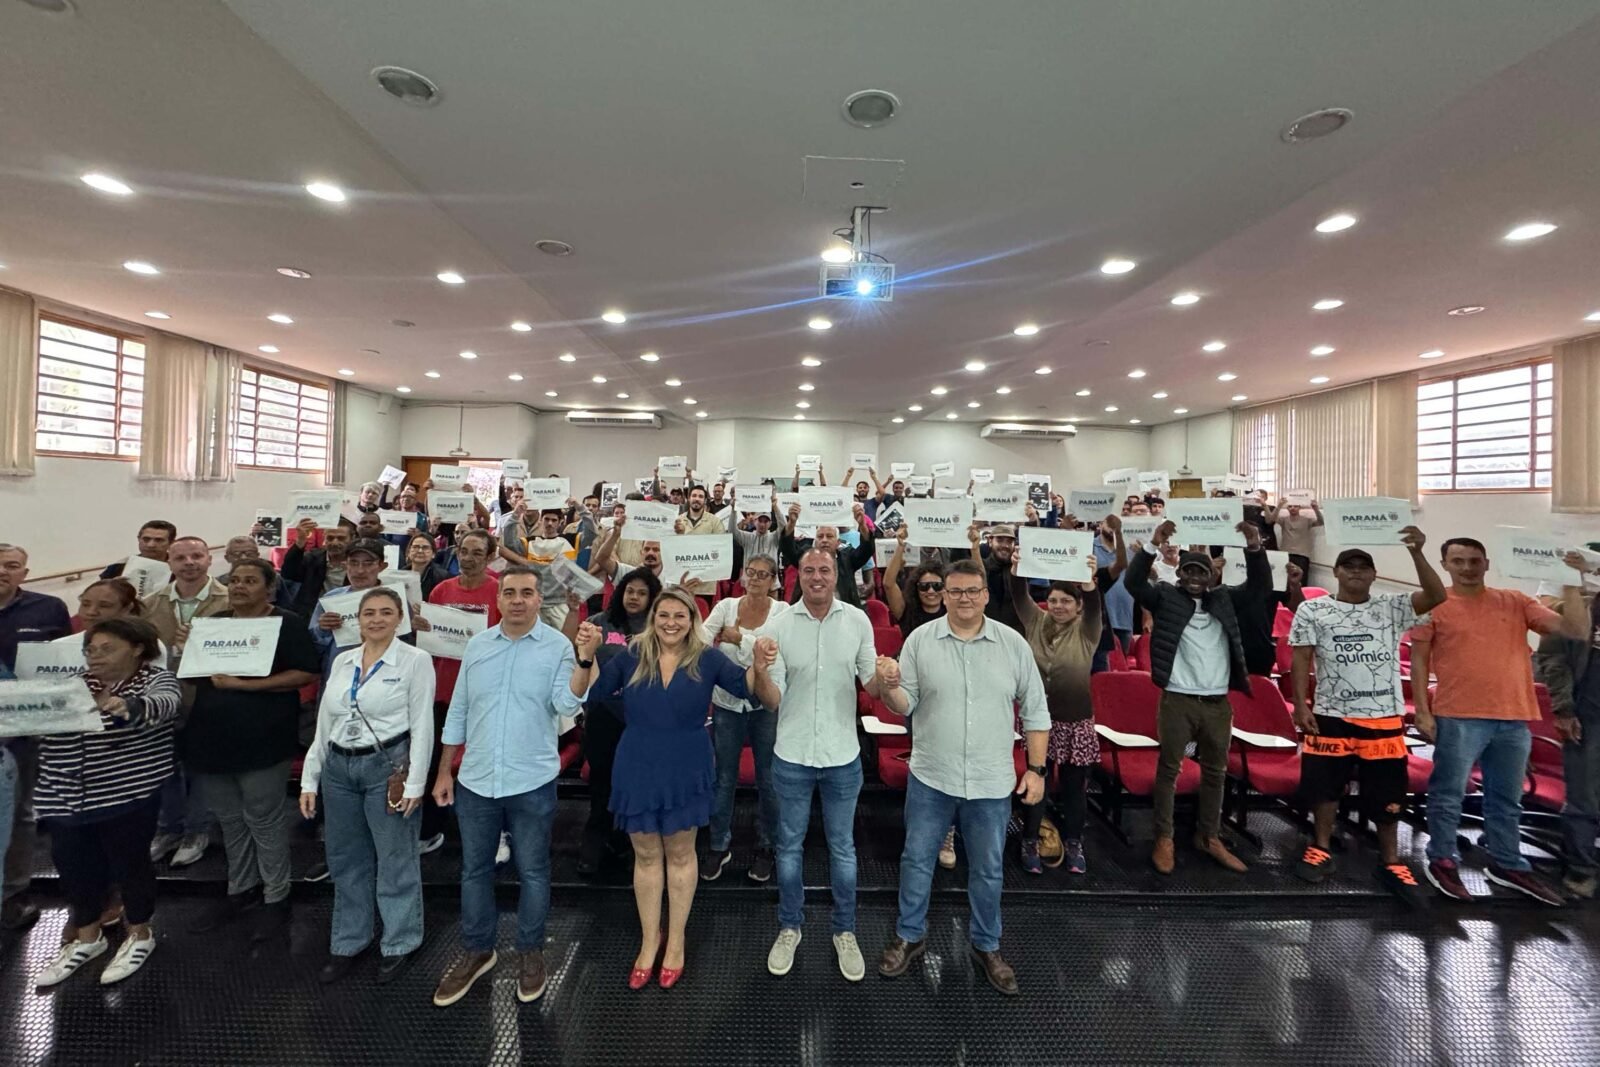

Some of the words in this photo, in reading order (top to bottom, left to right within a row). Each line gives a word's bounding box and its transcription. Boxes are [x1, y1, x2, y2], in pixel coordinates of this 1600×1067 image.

[917, 515, 952, 524] PARANÁ
[1182, 514, 1221, 522] PARANÁ
[1342, 513, 1388, 522] PARANÁ
[1032, 546, 1068, 556] PARANÁ
[675, 552, 710, 562] PARANÁ
[433, 624, 465, 636] PARANÁ
[203, 638, 248, 648] PARANÁ
[1334, 642, 1364, 652] neo
